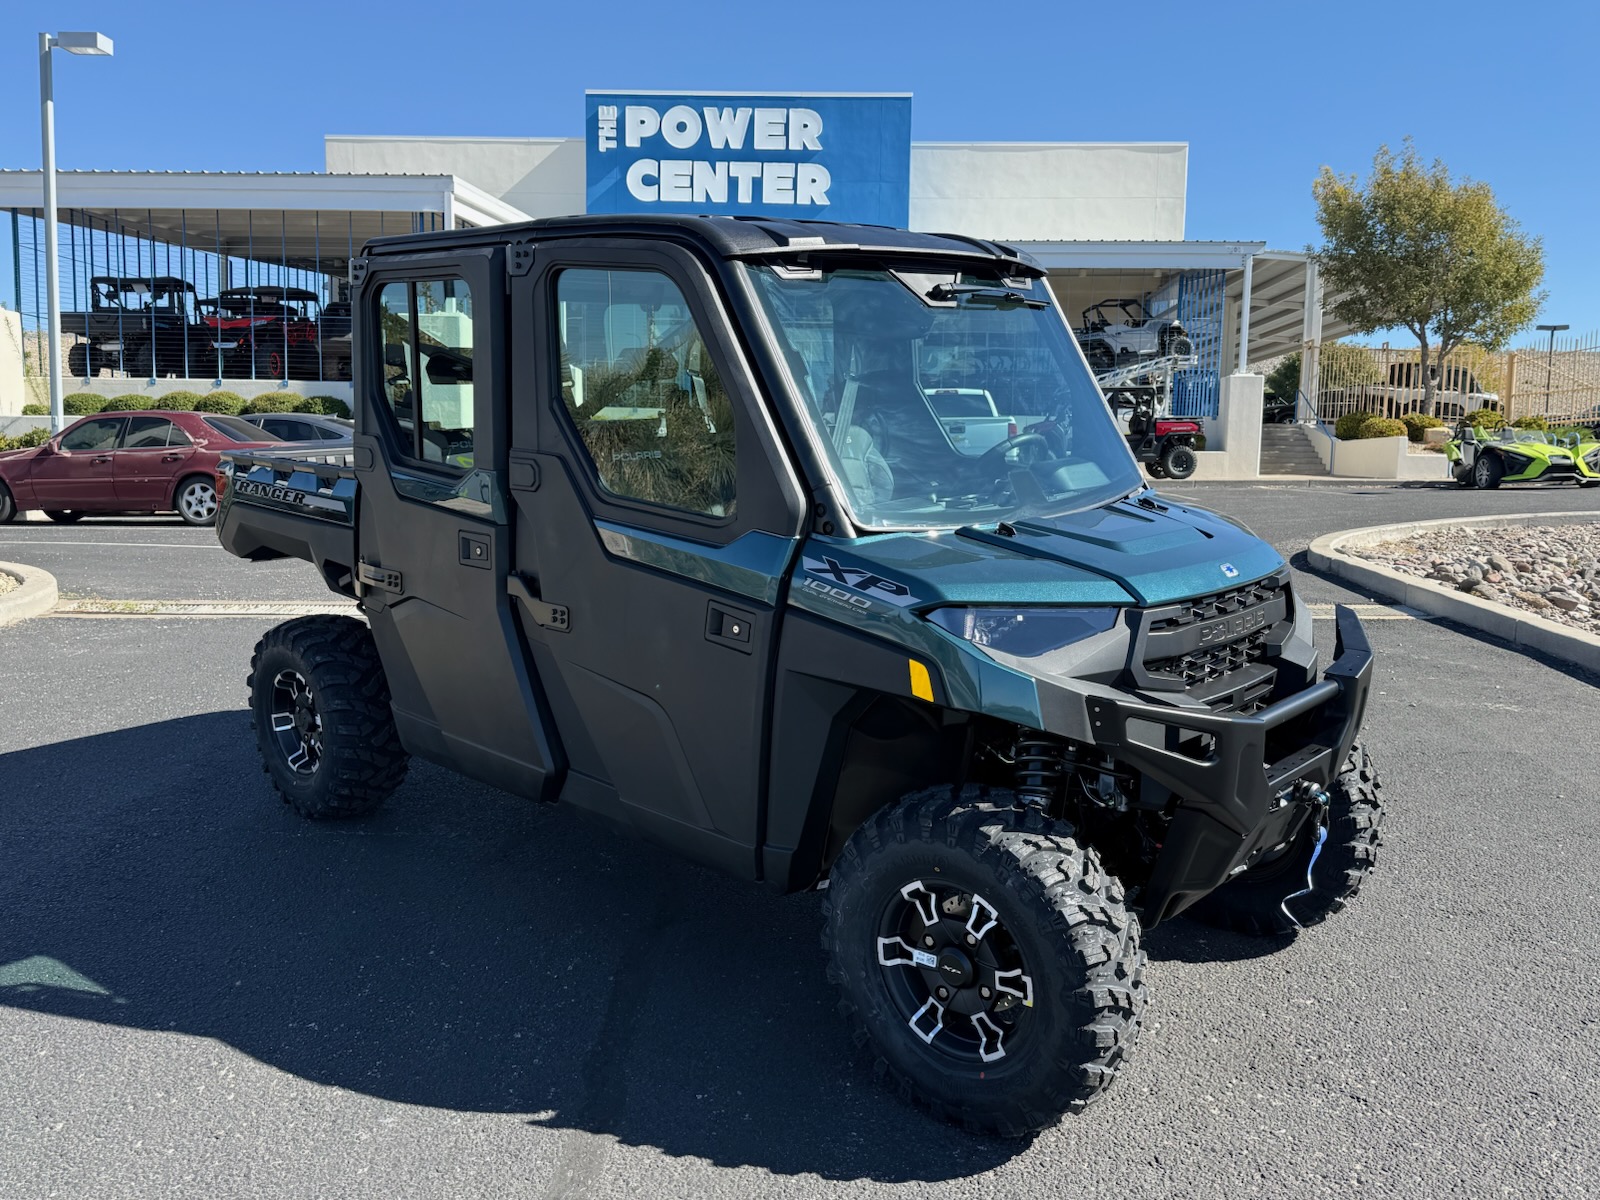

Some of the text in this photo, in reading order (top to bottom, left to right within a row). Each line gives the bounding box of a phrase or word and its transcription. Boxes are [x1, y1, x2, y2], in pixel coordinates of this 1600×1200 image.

[598, 105, 617, 152] THE
[625, 105, 823, 150] POWER
[626, 158, 831, 205] CENTER
[237, 480, 306, 506] RANGER
[803, 577, 872, 609] 1000
[804, 555, 911, 597] XP
[1200, 608, 1265, 645] POLARIS
